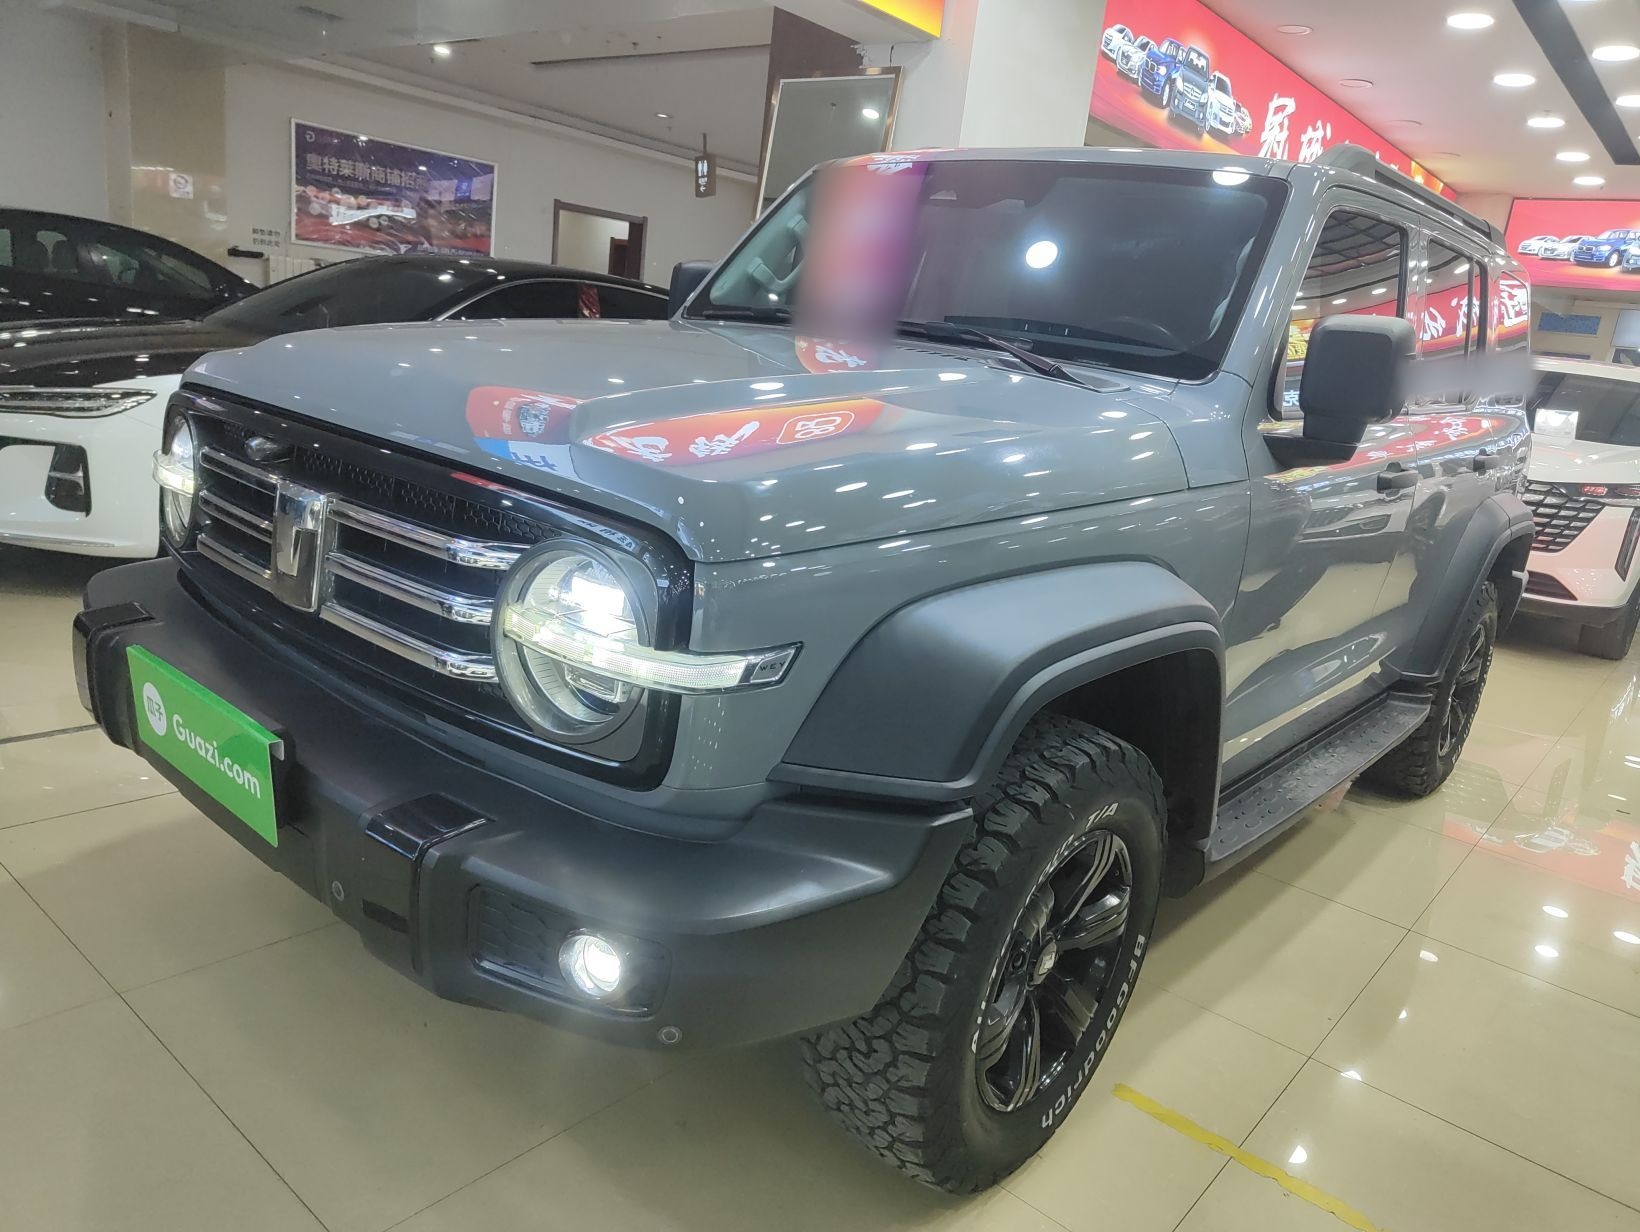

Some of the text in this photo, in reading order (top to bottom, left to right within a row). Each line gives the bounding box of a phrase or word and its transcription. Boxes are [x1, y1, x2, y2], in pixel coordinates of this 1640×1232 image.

[760, 661, 787, 672] WEY
[146, 695, 164, 723] 瓜子
[173, 713, 261, 799] Guazi.com
[1086, 802, 1119, 831] T/A
